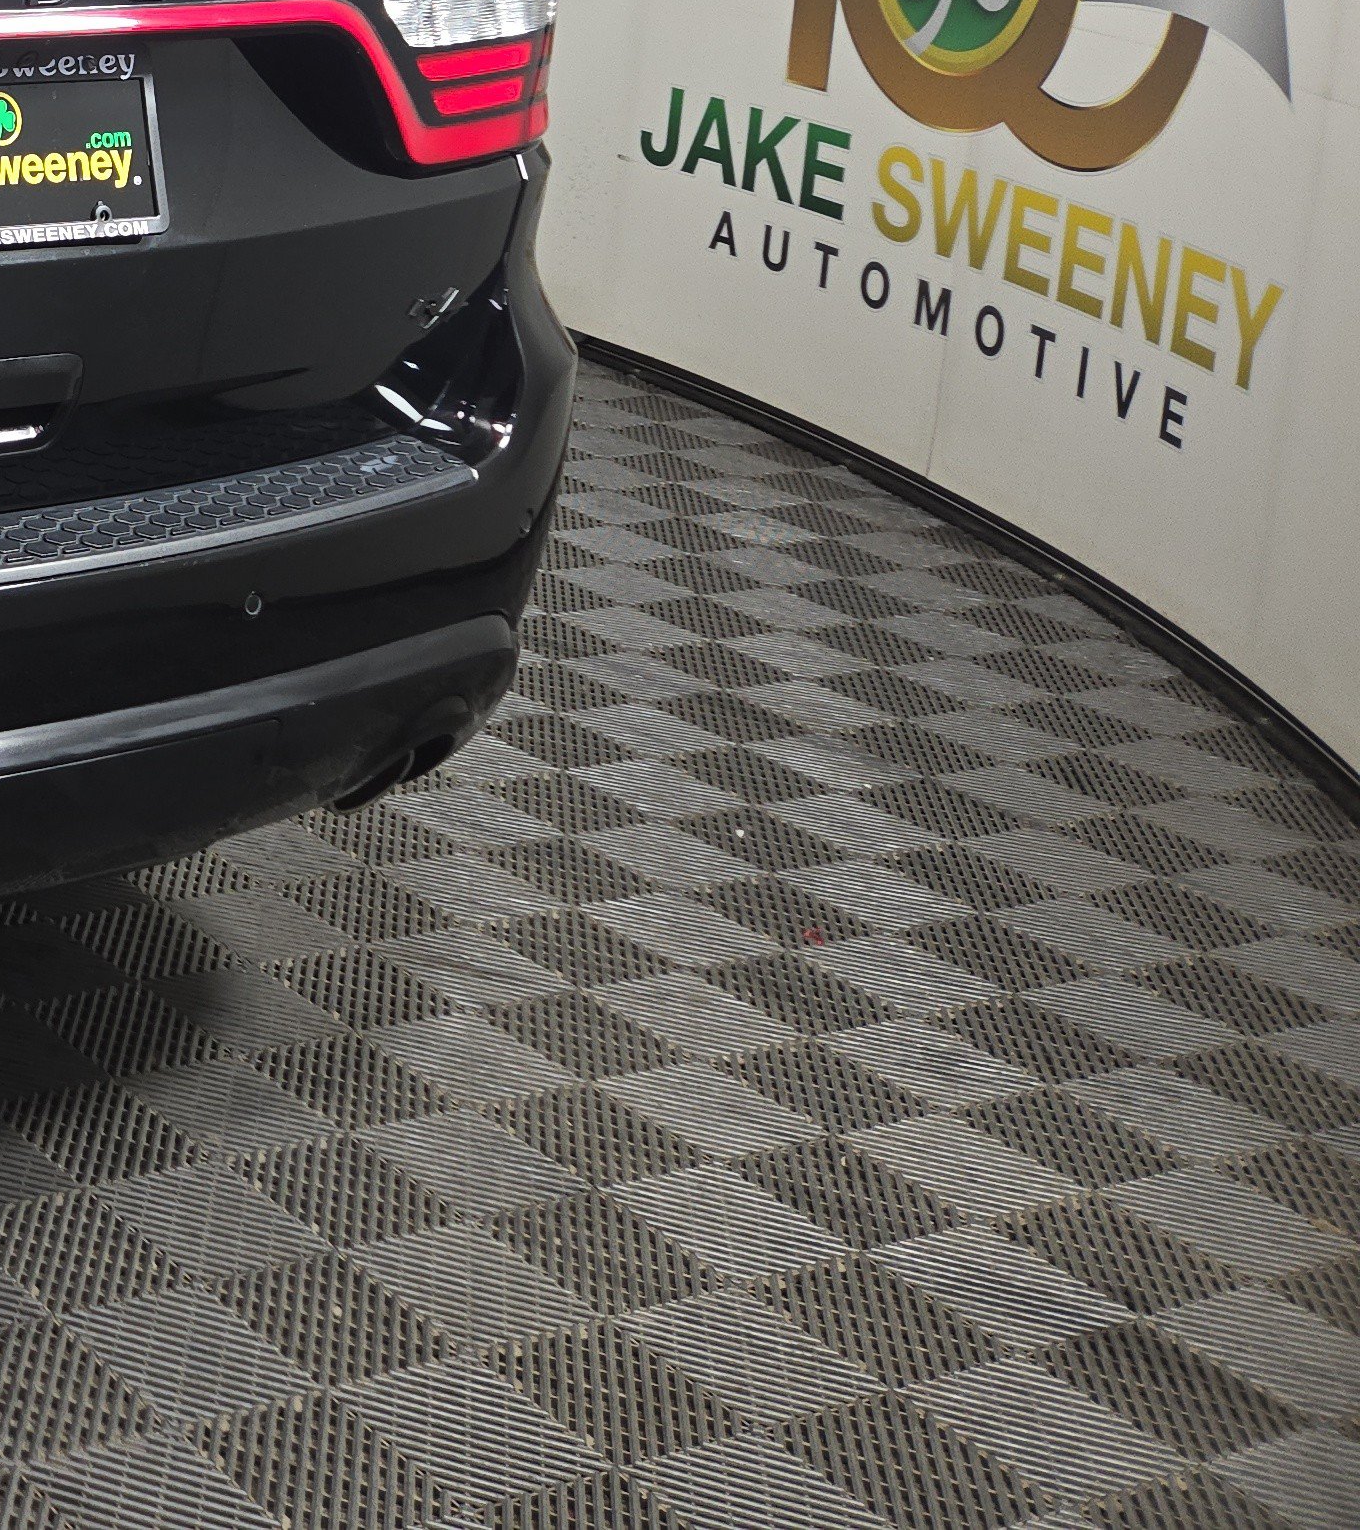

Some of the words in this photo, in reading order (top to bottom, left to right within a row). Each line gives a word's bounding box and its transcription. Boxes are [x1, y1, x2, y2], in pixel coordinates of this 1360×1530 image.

[640, 86, 852, 220] JAKE
[871, 145, 1284, 391] SWEENEY
[708, 210, 1188, 449] AUTOMOTIVE
